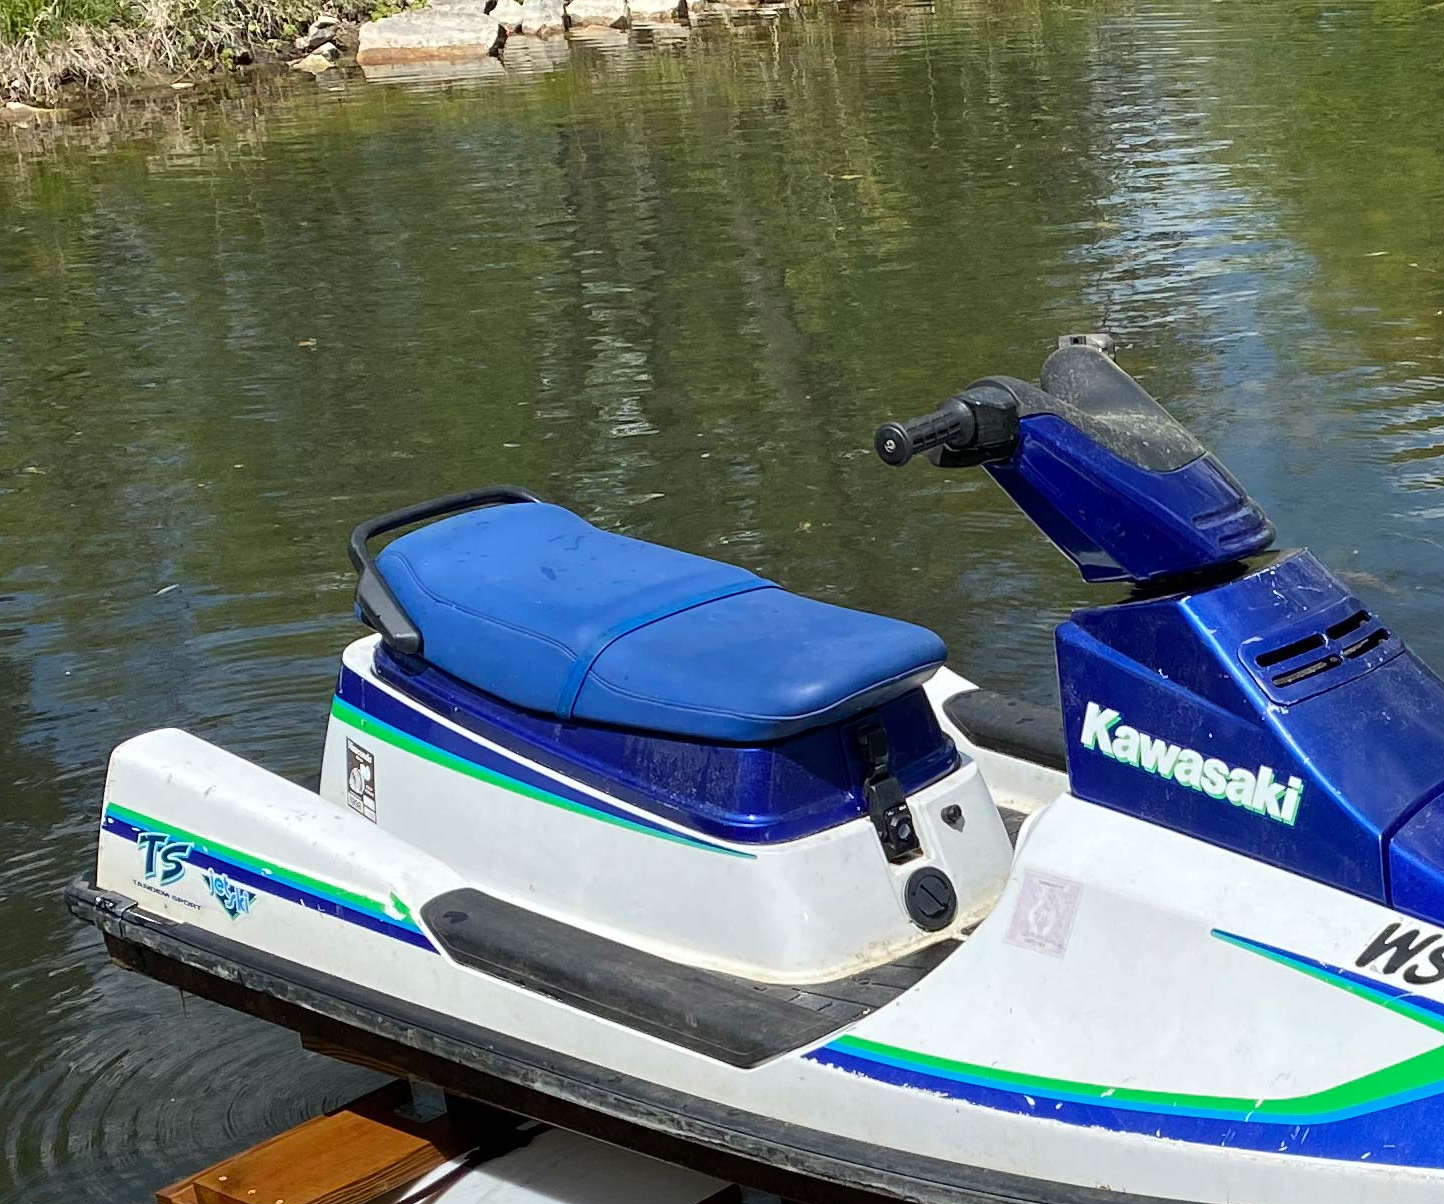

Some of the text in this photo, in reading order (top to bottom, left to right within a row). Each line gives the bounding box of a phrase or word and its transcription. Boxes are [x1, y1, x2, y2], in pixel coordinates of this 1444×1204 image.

[1081, 701, 1303, 826] Kawasaki
[138, 832, 194, 886] TS
[132, 880, 202, 911] TANDEM SPORT
